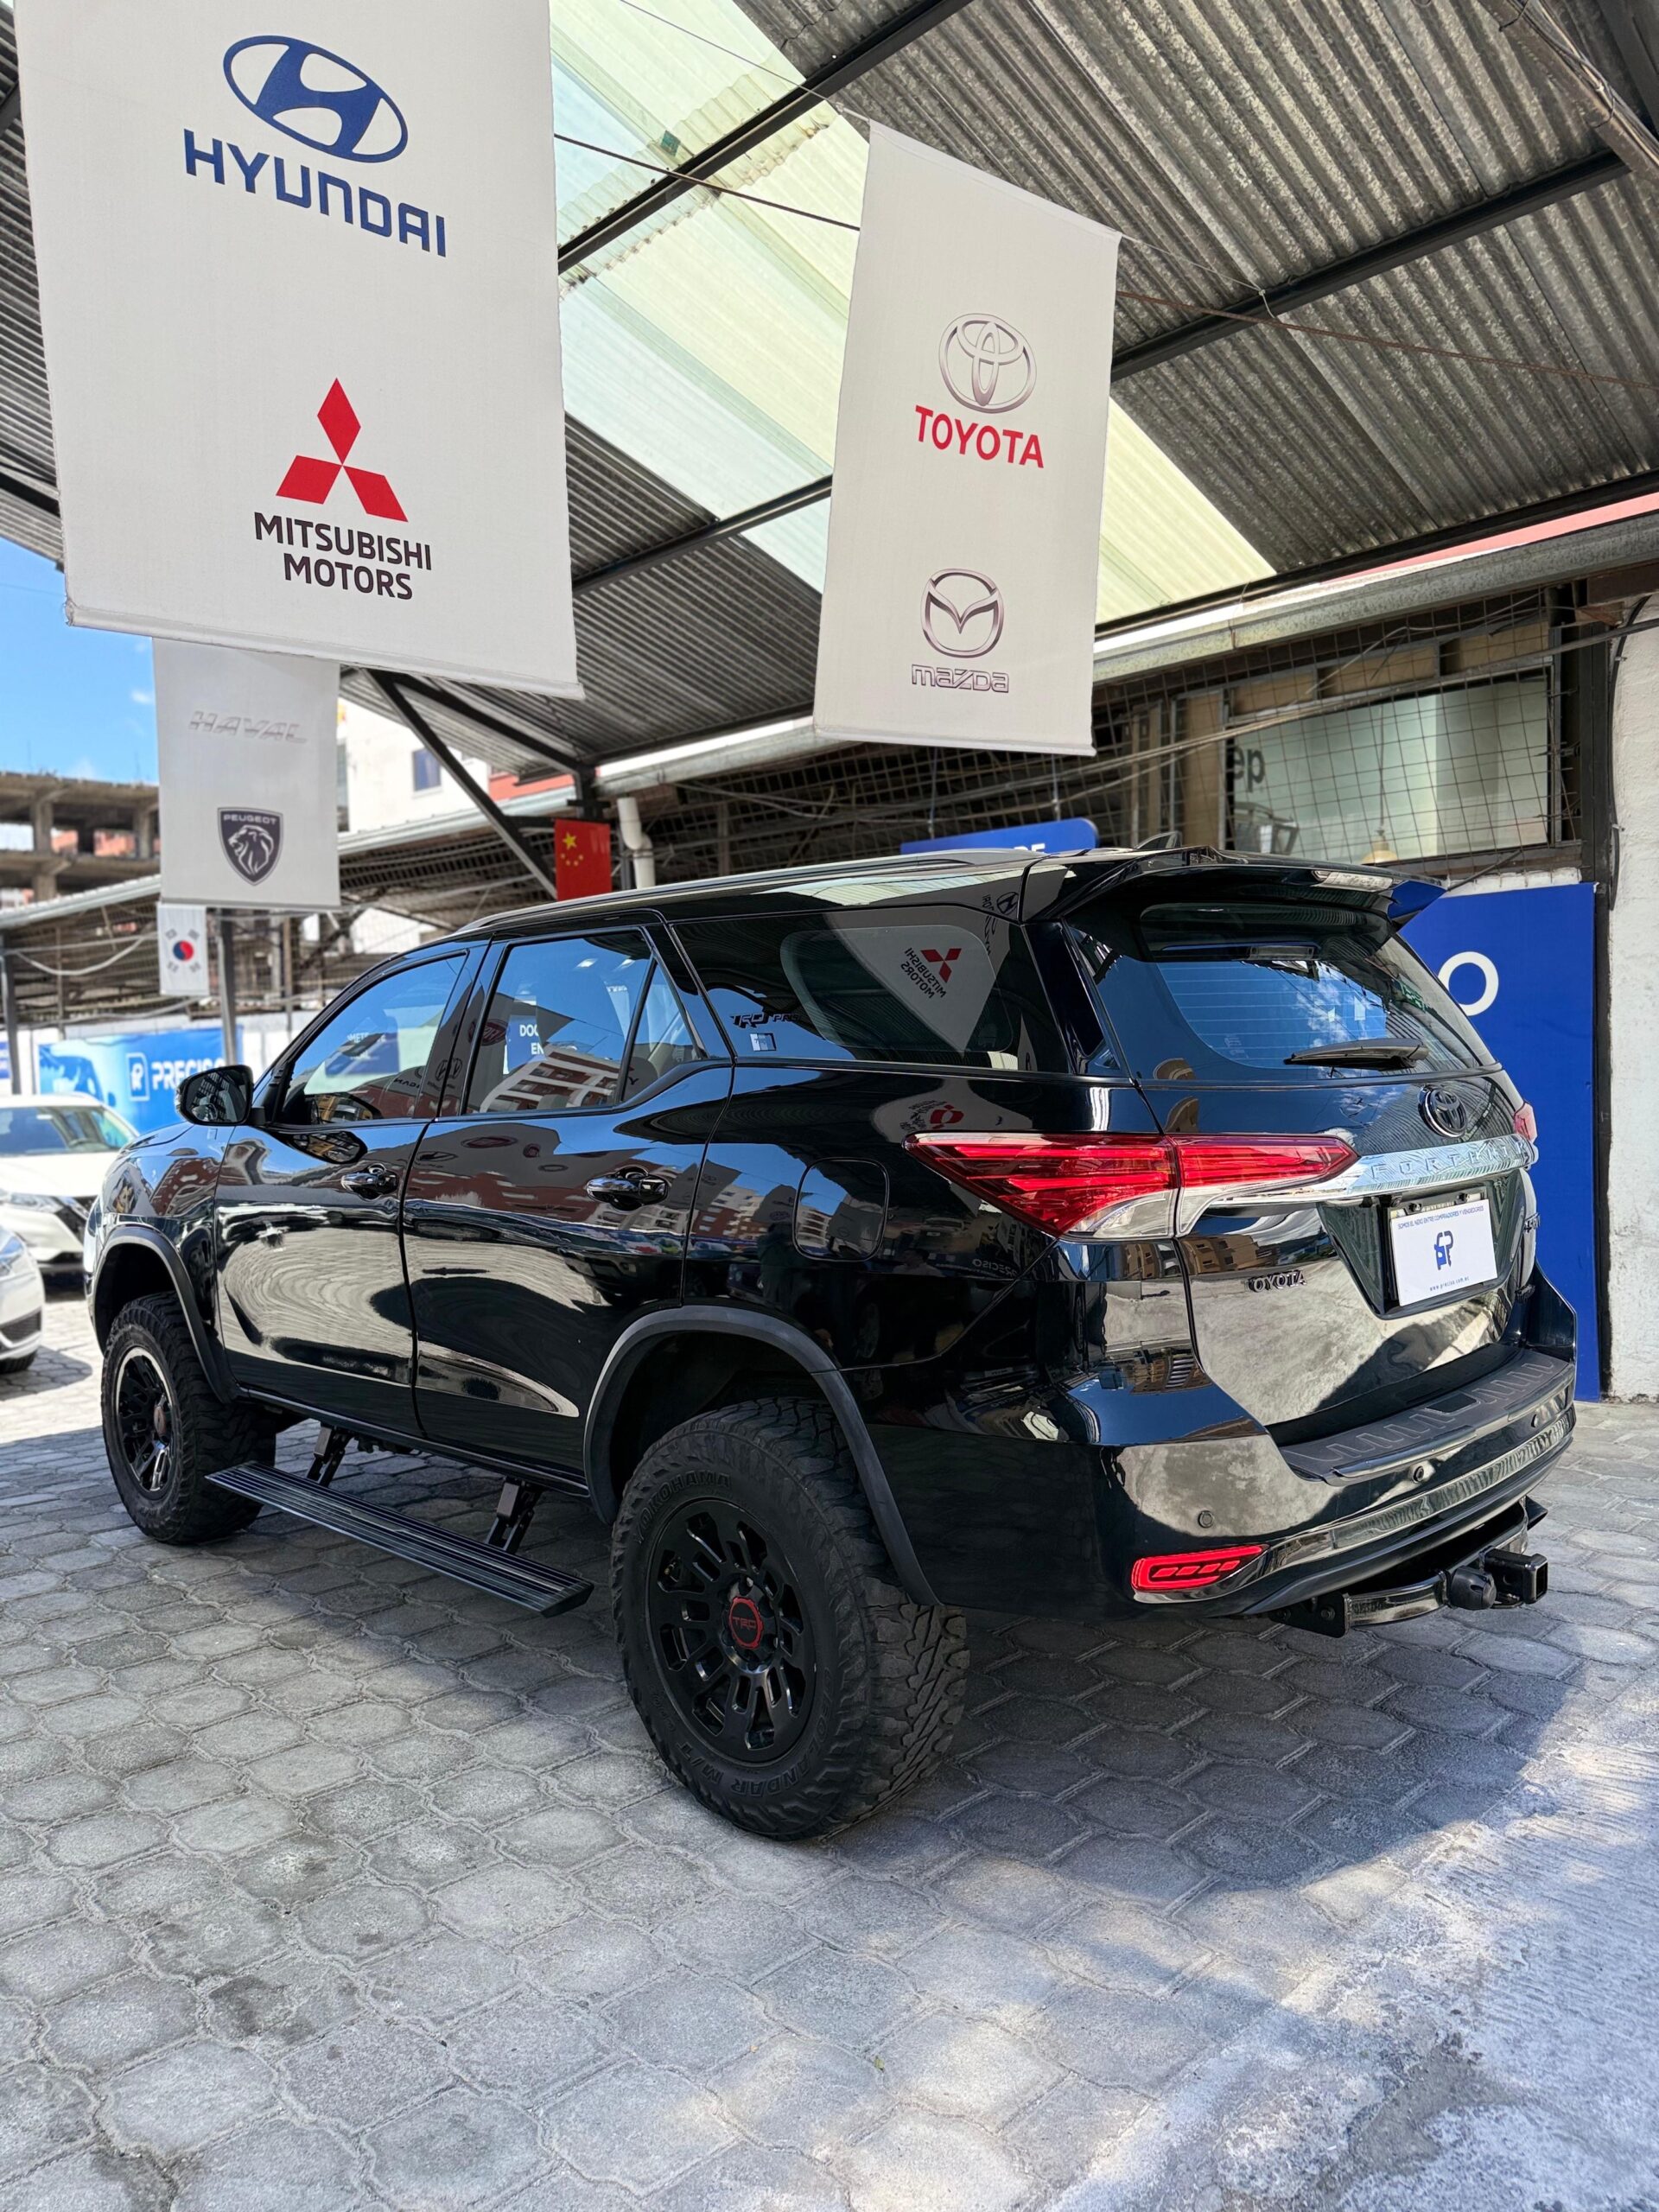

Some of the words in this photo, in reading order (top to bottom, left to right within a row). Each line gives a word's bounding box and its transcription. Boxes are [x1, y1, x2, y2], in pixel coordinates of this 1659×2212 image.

[183, 128, 448, 258] HYUNDAI
[914, 404, 1045, 469] TOYOTA
[254, 512, 433, 571] MITSUBISHI
[283, 553, 413, 601] MOTORS
[188, 710, 308, 744] HAVAL
[222, 813, 277, 825] PEUGEOT
[634, 1469, 732, 1544] YOKOHAMA
[732, 1614, 758, 1631] TRD
[676, 1739, 725, 1783] M/T
